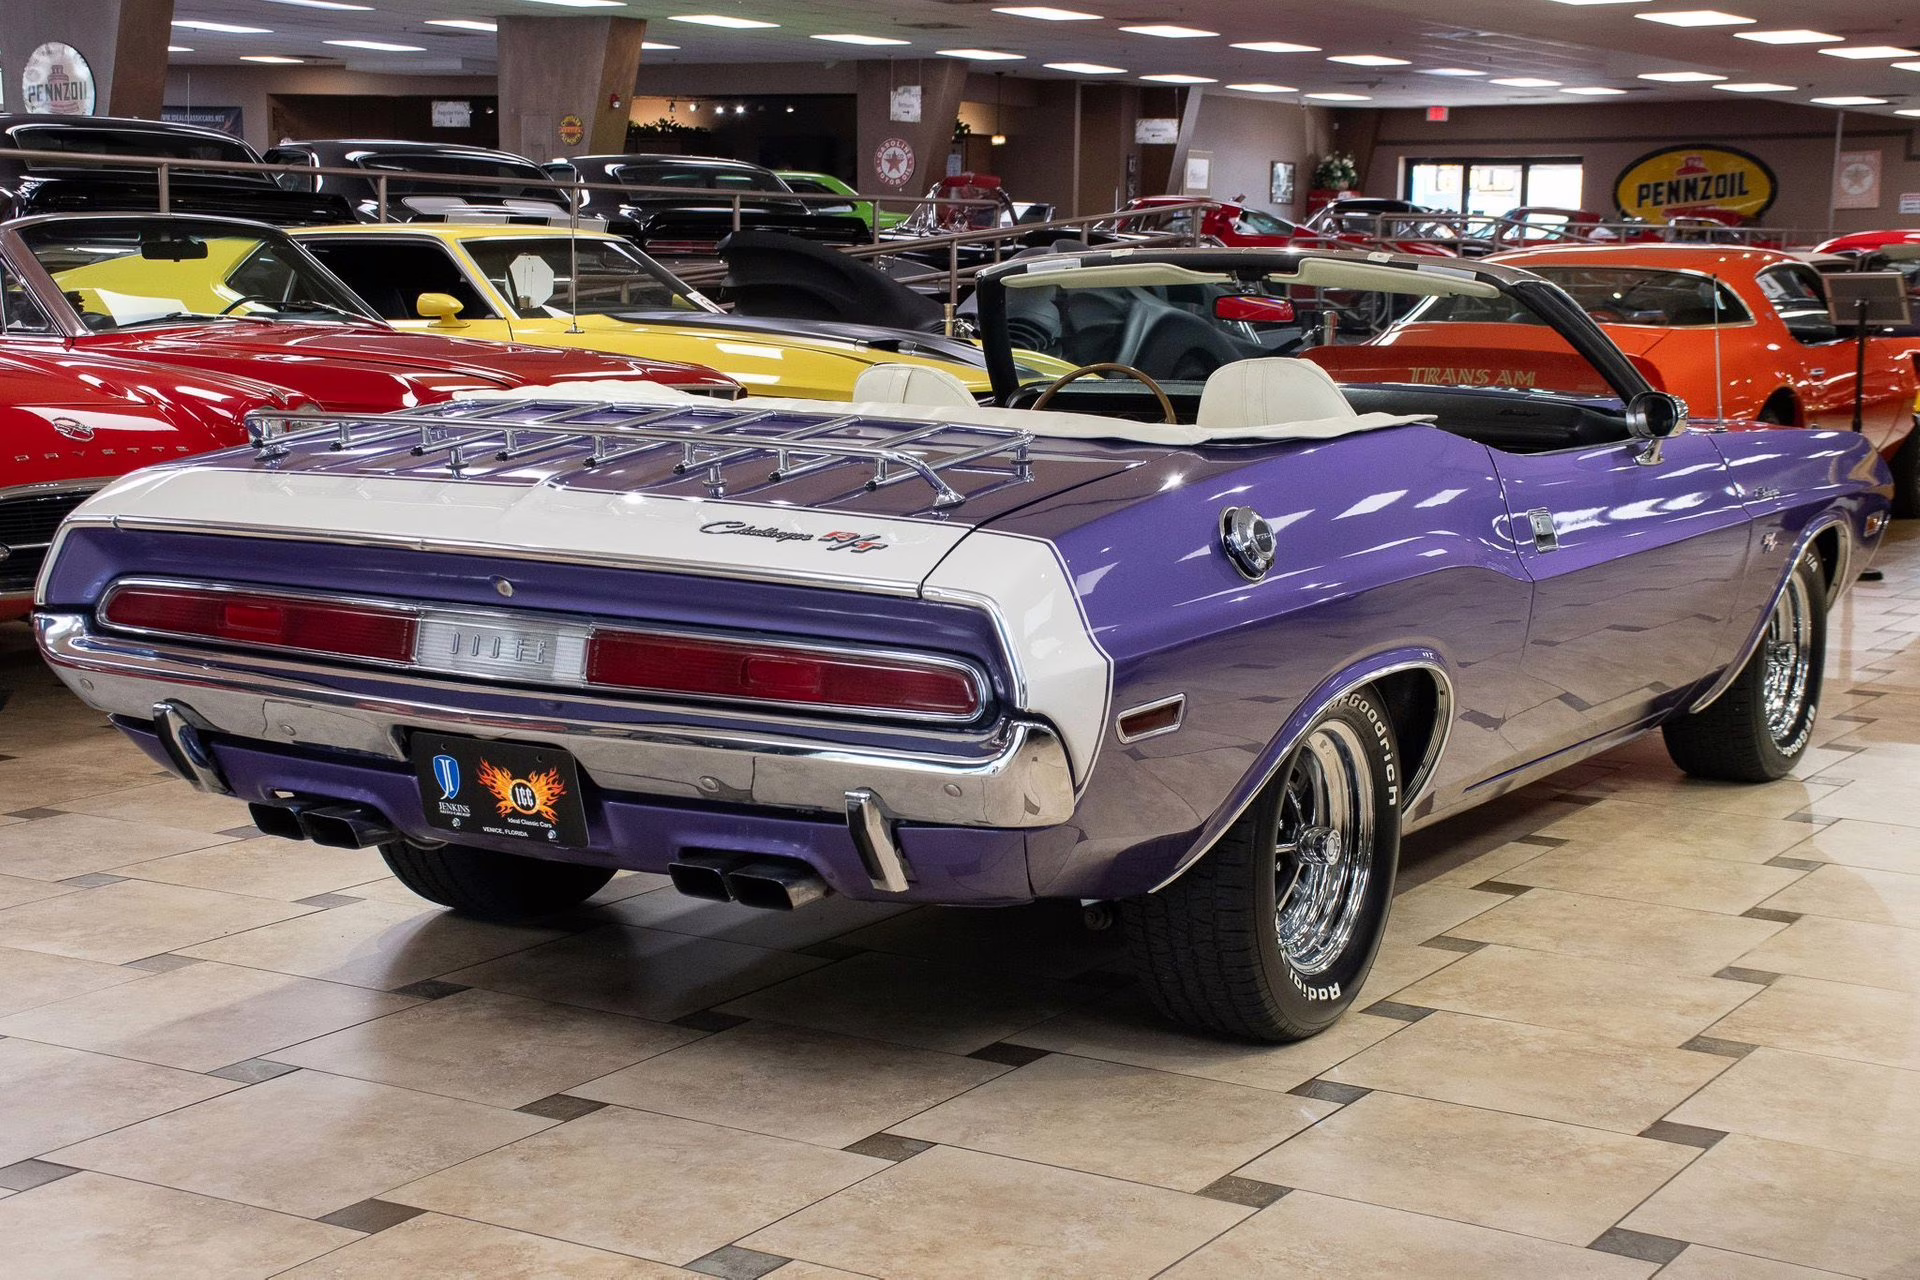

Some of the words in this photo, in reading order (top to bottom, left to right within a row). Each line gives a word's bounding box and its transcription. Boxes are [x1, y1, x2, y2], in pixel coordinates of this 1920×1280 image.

[877, 140, 912, 158] GASOLINE
[876, 167, 901, 185] MOTOR
[902, 166, 912, 181] OIL
[1637, 171, 1749, 208] PENNZOIL
[1408, 367, 1490, 385] TRANS
[1494, 370, 1535, 386] AM
[699, 521, 814, 542] Challenger
[818, 530, 889, 553] R/T
[1805, 553, 1818, 573] T/A
[450, 631, 546, 664] DODGE
[438, 801, 471, 813] JENKINS
[482, 826, 504, 835] VENICE,
[504, 828, 528, 837] FLORIDA
[507, 817, 520, 825] Ideal
[520, 818, 539, 827] Classic
[539, 821, 552, 829] Cars
[1289, 967, 1341, 1001] Radial
